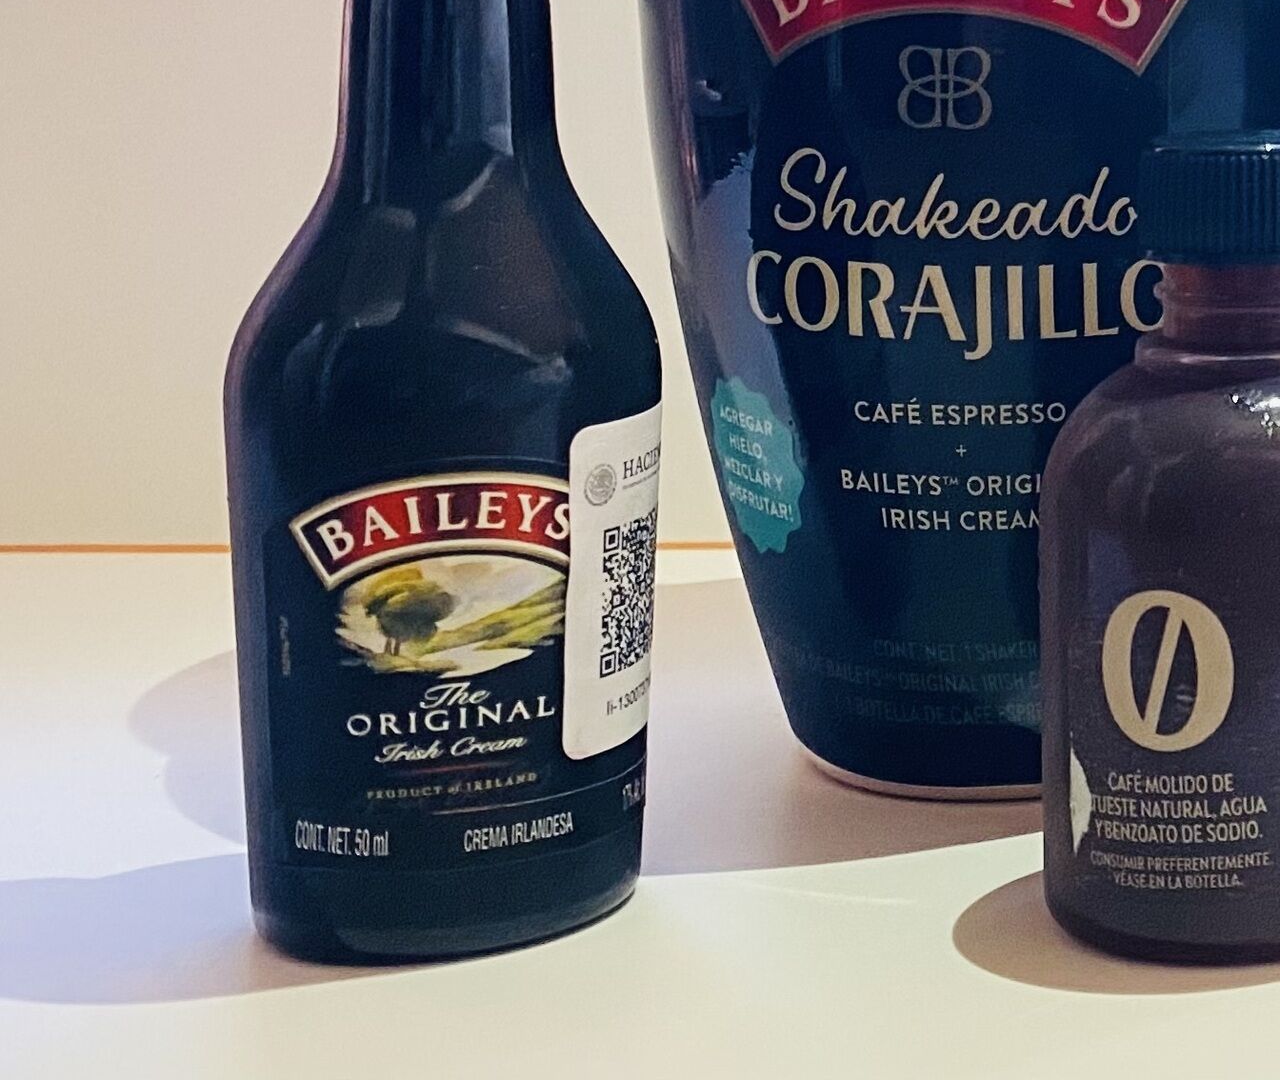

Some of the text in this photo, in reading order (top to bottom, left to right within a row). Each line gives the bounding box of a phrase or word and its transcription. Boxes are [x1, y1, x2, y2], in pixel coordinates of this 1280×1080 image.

[773, 148, 1139, 241] Shakeado
[720, 404, 773, 438] AGREGAR
[854, 398, 1067, 426] CAFÉ ESPRESSO
[775, 473, 784, 492] Y
[317, 491, 571, 563] BAILEYS
[881, 507, 950, 531] IRISH
[419, 681, 490, 710] The
[347, 695, 556, 737] ORIGINAL
[374, 735, 527, 764] Irish Cream
[367, 784, 442, 802] PRODUCT
[465, 771, 537, 796] IRELAND
[1107, 770, 1235, 795] CAFÉ MOLIDO DE
[1219, 795, 1268, 817] AGUA
[295, 819, 389, 857] CONT. NET. 50 ml
[464, 811, 574, 854] CREMA IRLANDESA
[1094, 819, 1264, 844] Y BENZOATO DE SODIO.
[1090, 850, 1146, 870] CONSUMIR
[1167, 875, 1182, 889] LA
